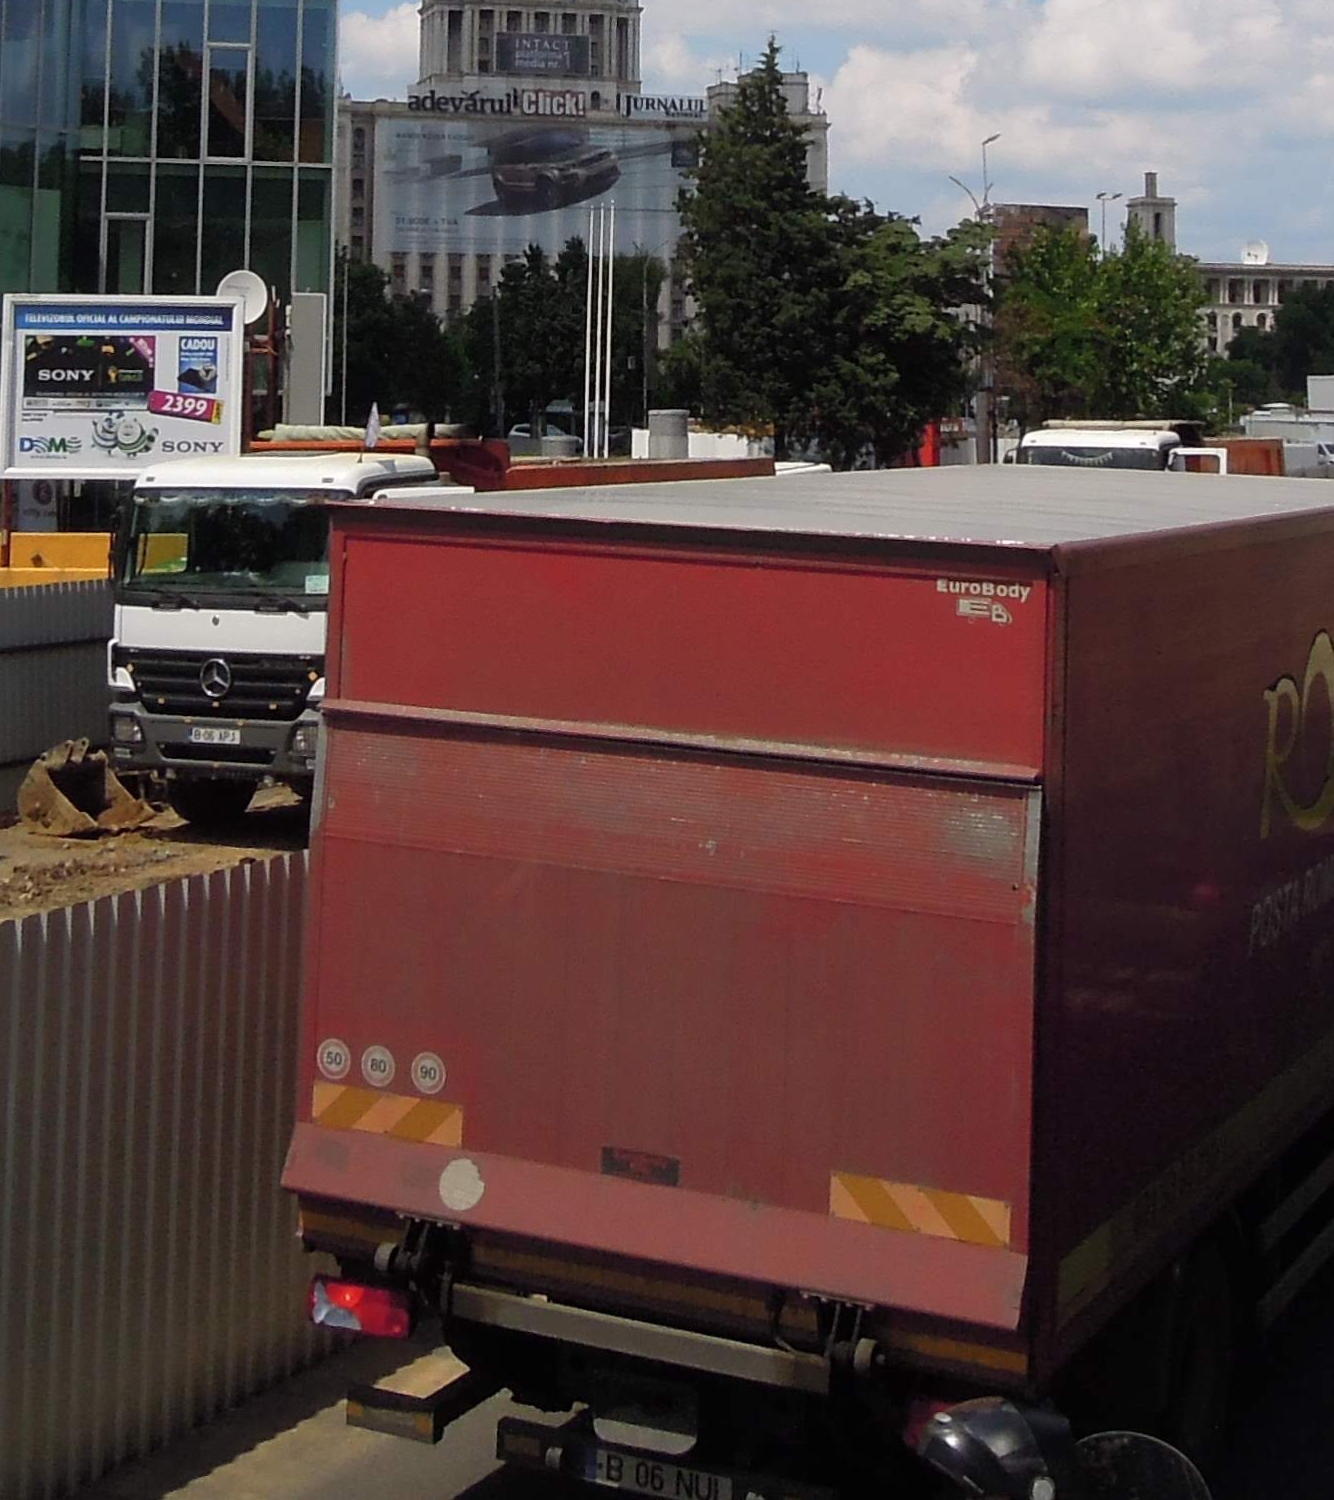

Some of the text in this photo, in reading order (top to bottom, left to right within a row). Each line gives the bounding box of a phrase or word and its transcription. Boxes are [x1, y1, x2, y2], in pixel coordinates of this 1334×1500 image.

[515, 38, 569, 51] INTACT
[408, 89, 512, 114] adevărul
[522, 91, 585, 116] Click!
[622, 94, 708, 117] JURNALUL
[181, 338, 215, 350] CADOU
[37, 369, 94, 381] SONY
[161, 394, 207, 416] 2399
[161, 441, 225, 453] SONY
[936, 578, 1031, 603] EuroBody
[325, 1051, 343, 1066] 50
[370, 1058, 387, 1073] 80
[419, 1065, 437, 1080] 90
[606, 1454, 624, 1482] B
[635, 1460, 664, 1491] 06
